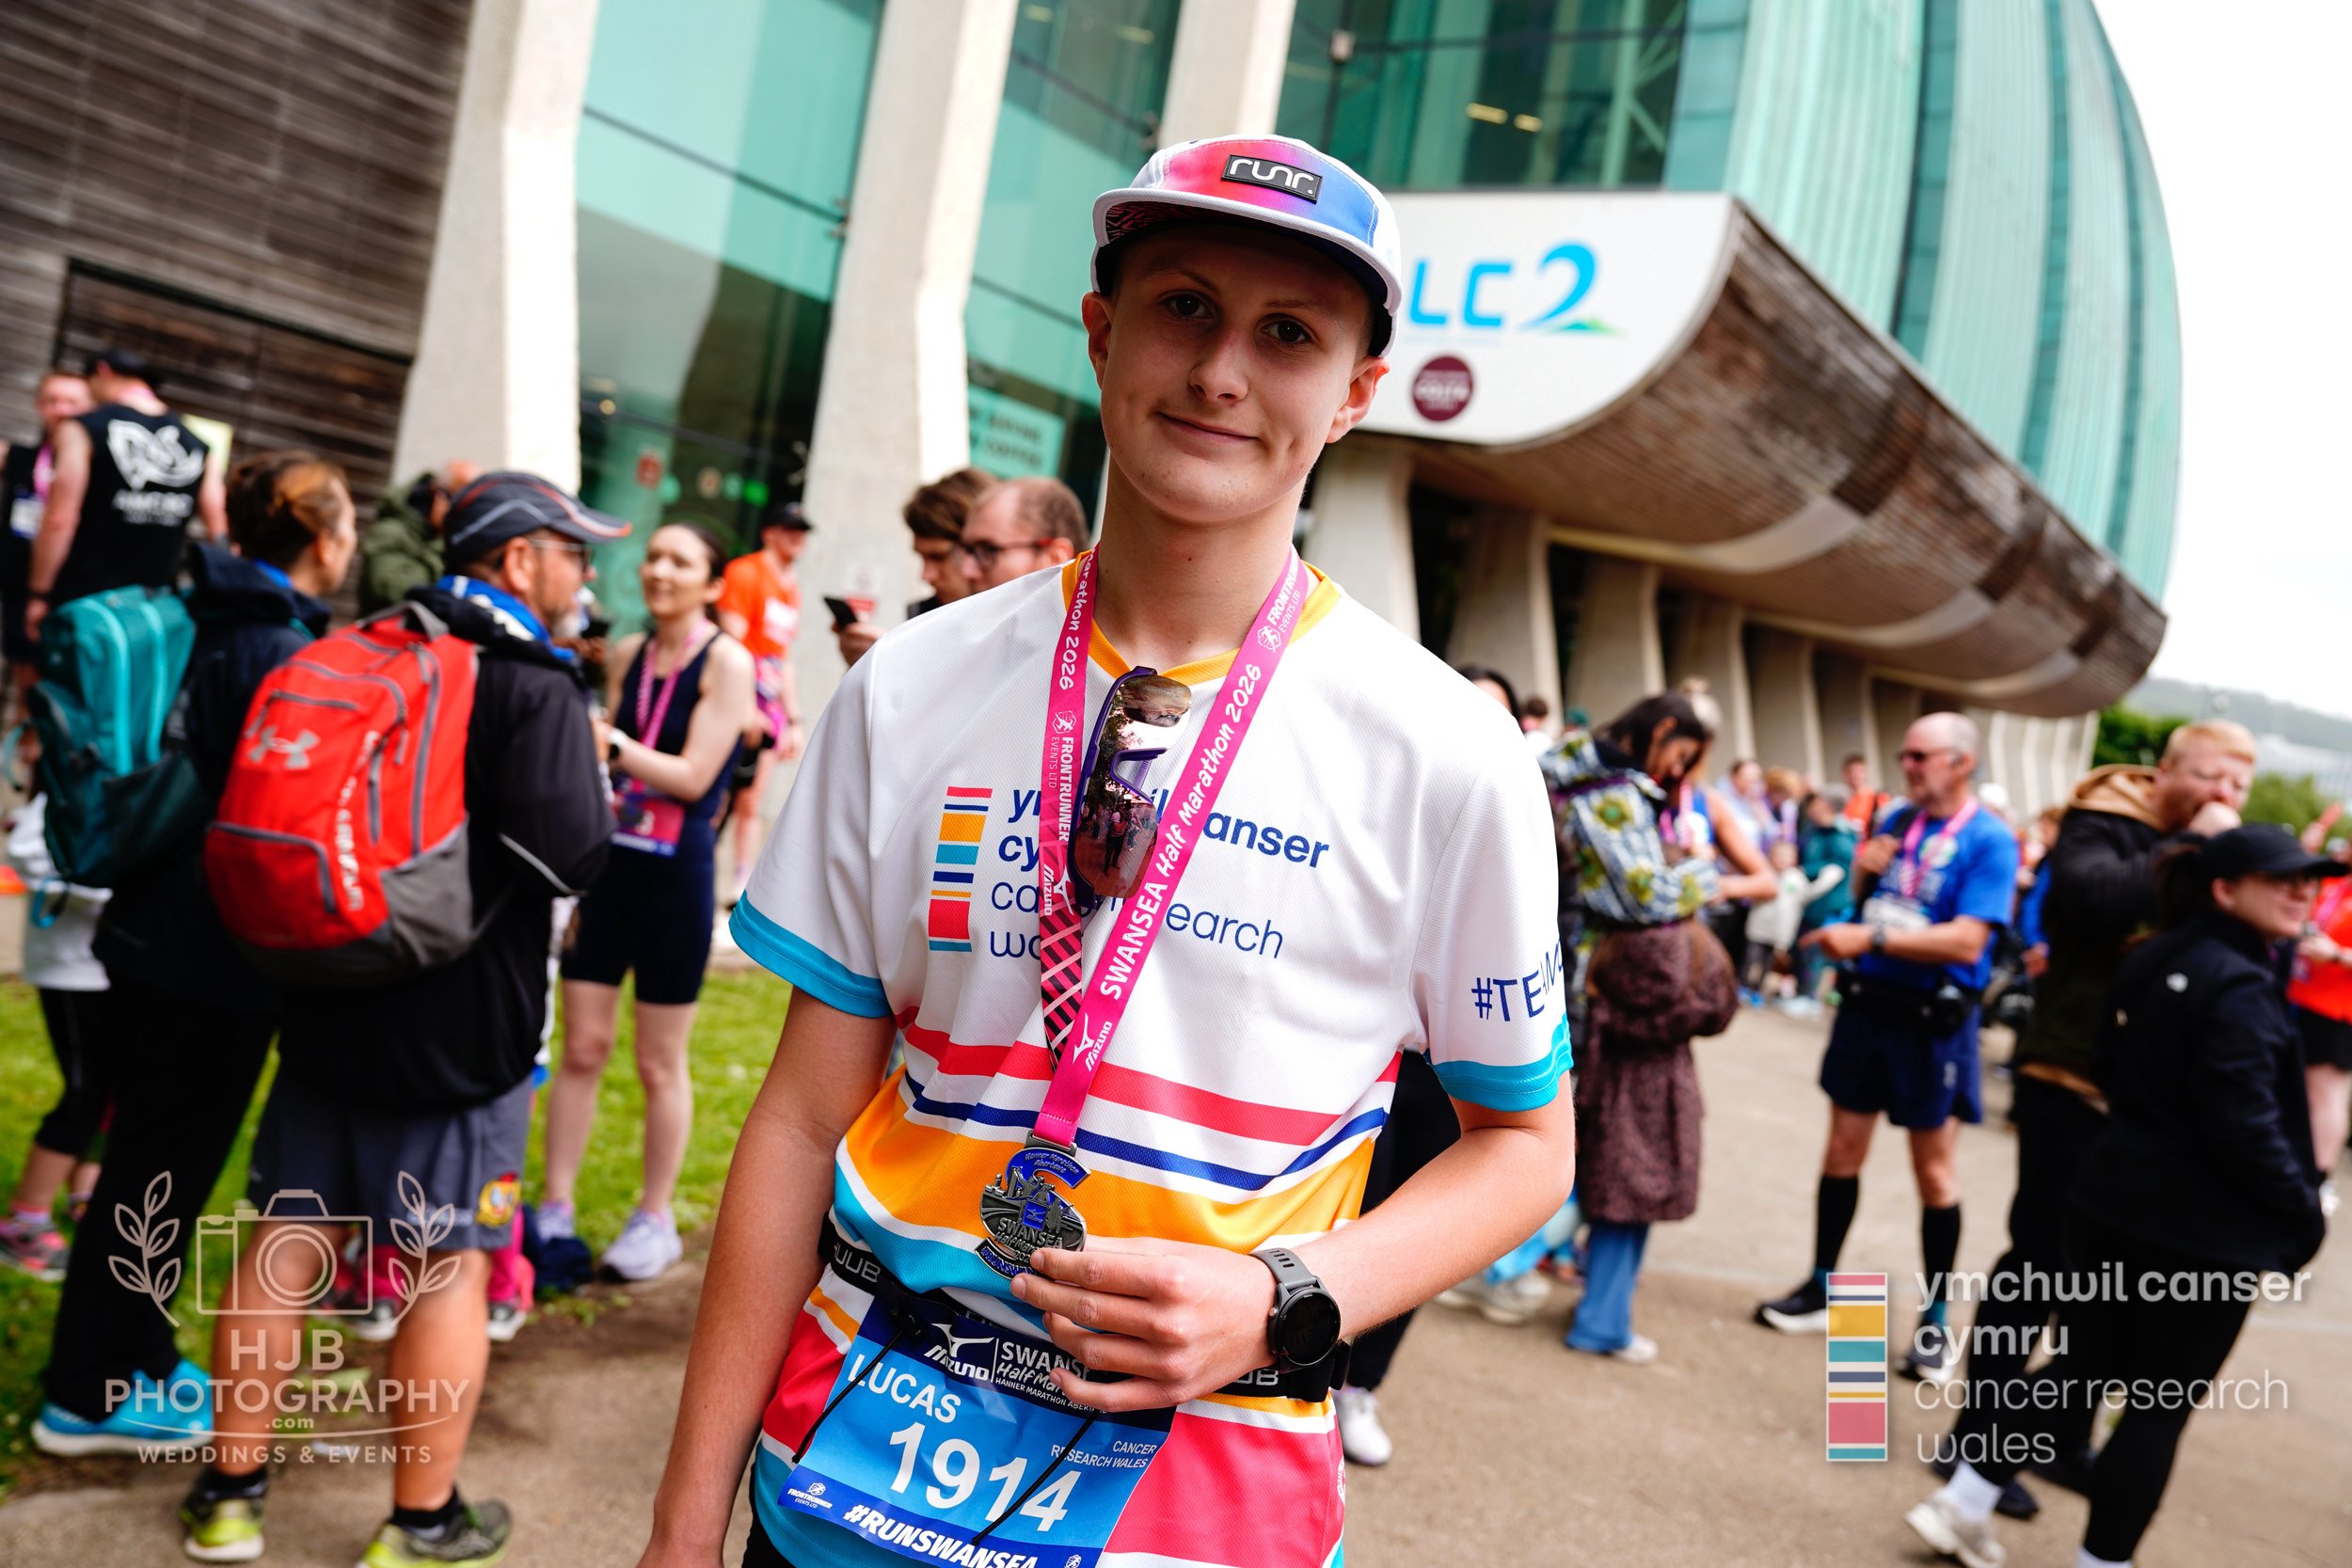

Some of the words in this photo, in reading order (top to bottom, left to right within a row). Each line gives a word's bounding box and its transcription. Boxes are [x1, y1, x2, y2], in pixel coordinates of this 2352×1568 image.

[1279, 603, 1296, 633] EVENTS
[1059, 636, 1079, 691] 2026
[1050, 736, 1060, 769] EVENTS
[1049, 772, 1058, 788] LTD
[1058, 736, 1074, 842] FRONTRUNNER
[1100, 881, 1169, 1001] SWANSEA
[1155, 823, 1186, 878] Half
[1178, 721, 1235, 827] Marathon
[1225, 663, 1262, 723] 2026
[1202, 811, 1330, 869] anser
[1165, 902, 1284, 959] earch
[998, 1217, 1063, 1250] SWANSEA
[1013, 1249, 1031, 1263] 202
[1000, 1341, 1090, 1381] SWANS
[848, 1353, 962, 1423] LUCAS
[995, 1377, 1025, 1392] HANNER
[1025, 1386, 1067, 1406] MARATHON
[1112, 1440, 1158, 1454] CANCER
[1112, 1457, 1149, 1468] WALES
[890, 1421, 1082, 1531] 1914
